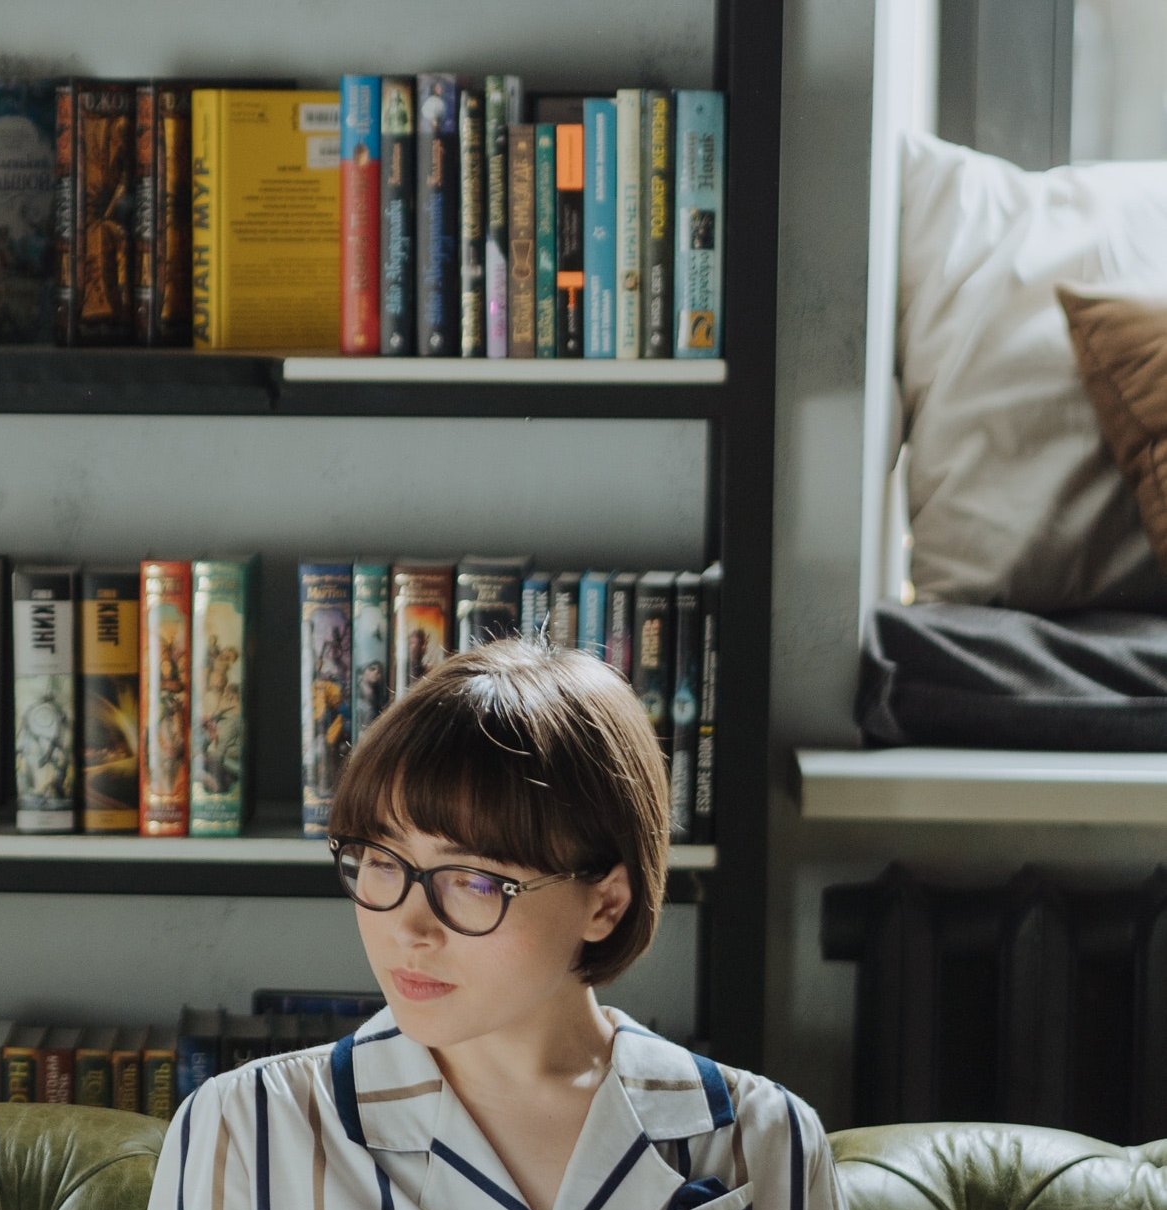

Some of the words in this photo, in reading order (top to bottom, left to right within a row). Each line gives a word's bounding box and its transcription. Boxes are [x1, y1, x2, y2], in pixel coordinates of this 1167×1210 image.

[652, 97, 667, 170] ЖЕЛЯЗНЫ
[193, 156, 210, 230] МУР
[651, 175, 665, 239] РОДЖЕР
[623, 183, 637, 267] ПРАТЧЕТТ
[193, 245, 210, 344] АЛАН
[623, 293, 636, 348] ТЕРРИ
[31, 604, 55, 654] КИНГ
[98, 602, 119, 646] КИНГ
[555, 592, 570, 641] КЛАРК
[698, 736, 713, 769] BOOK
[696, 770, 712, 815] ESCAPE
